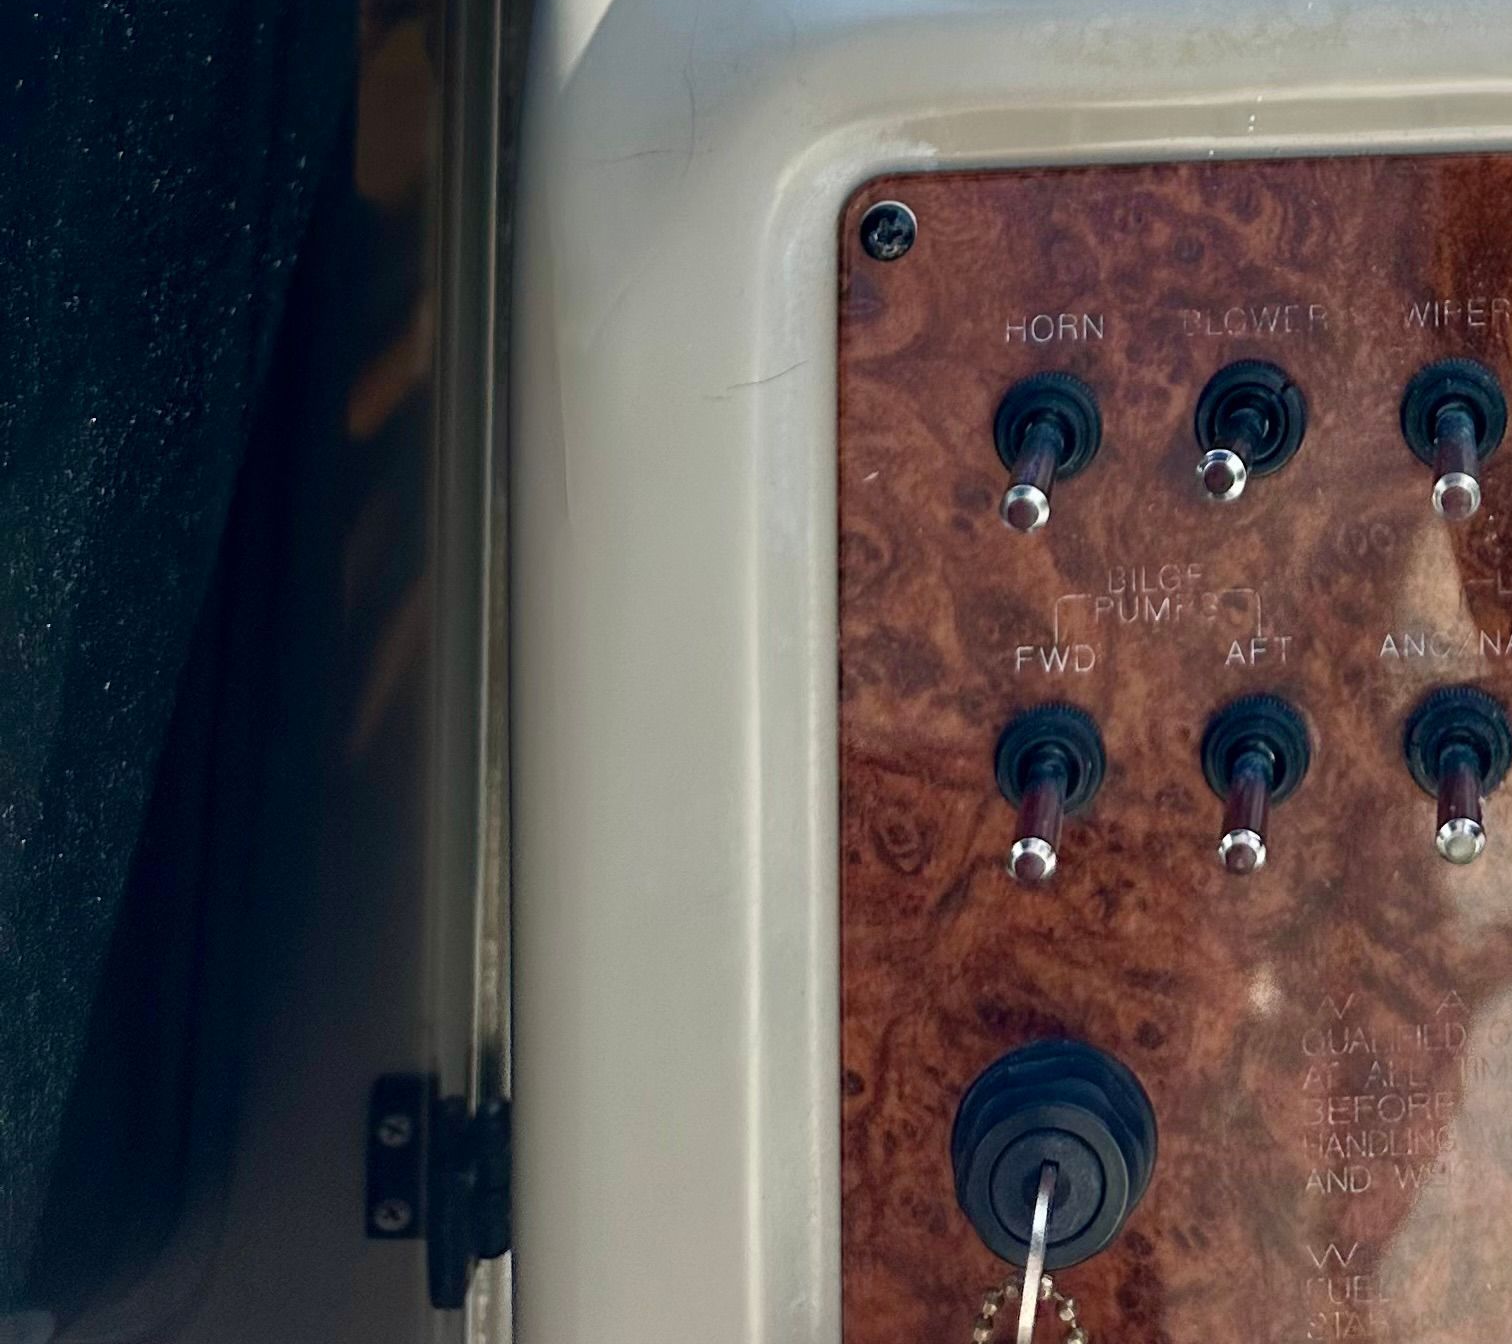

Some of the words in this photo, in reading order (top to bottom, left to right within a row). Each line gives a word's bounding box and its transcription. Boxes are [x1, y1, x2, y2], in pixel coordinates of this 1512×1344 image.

[1005, 313, 1105, 344] HORN
[1014, 645, 1096, 673] FWD
[1224, 636, 1293, 668] AFT
[1302, 1092, 1456, 1126] BEFORE
[1304, 1165, 1372, 1194] AND
